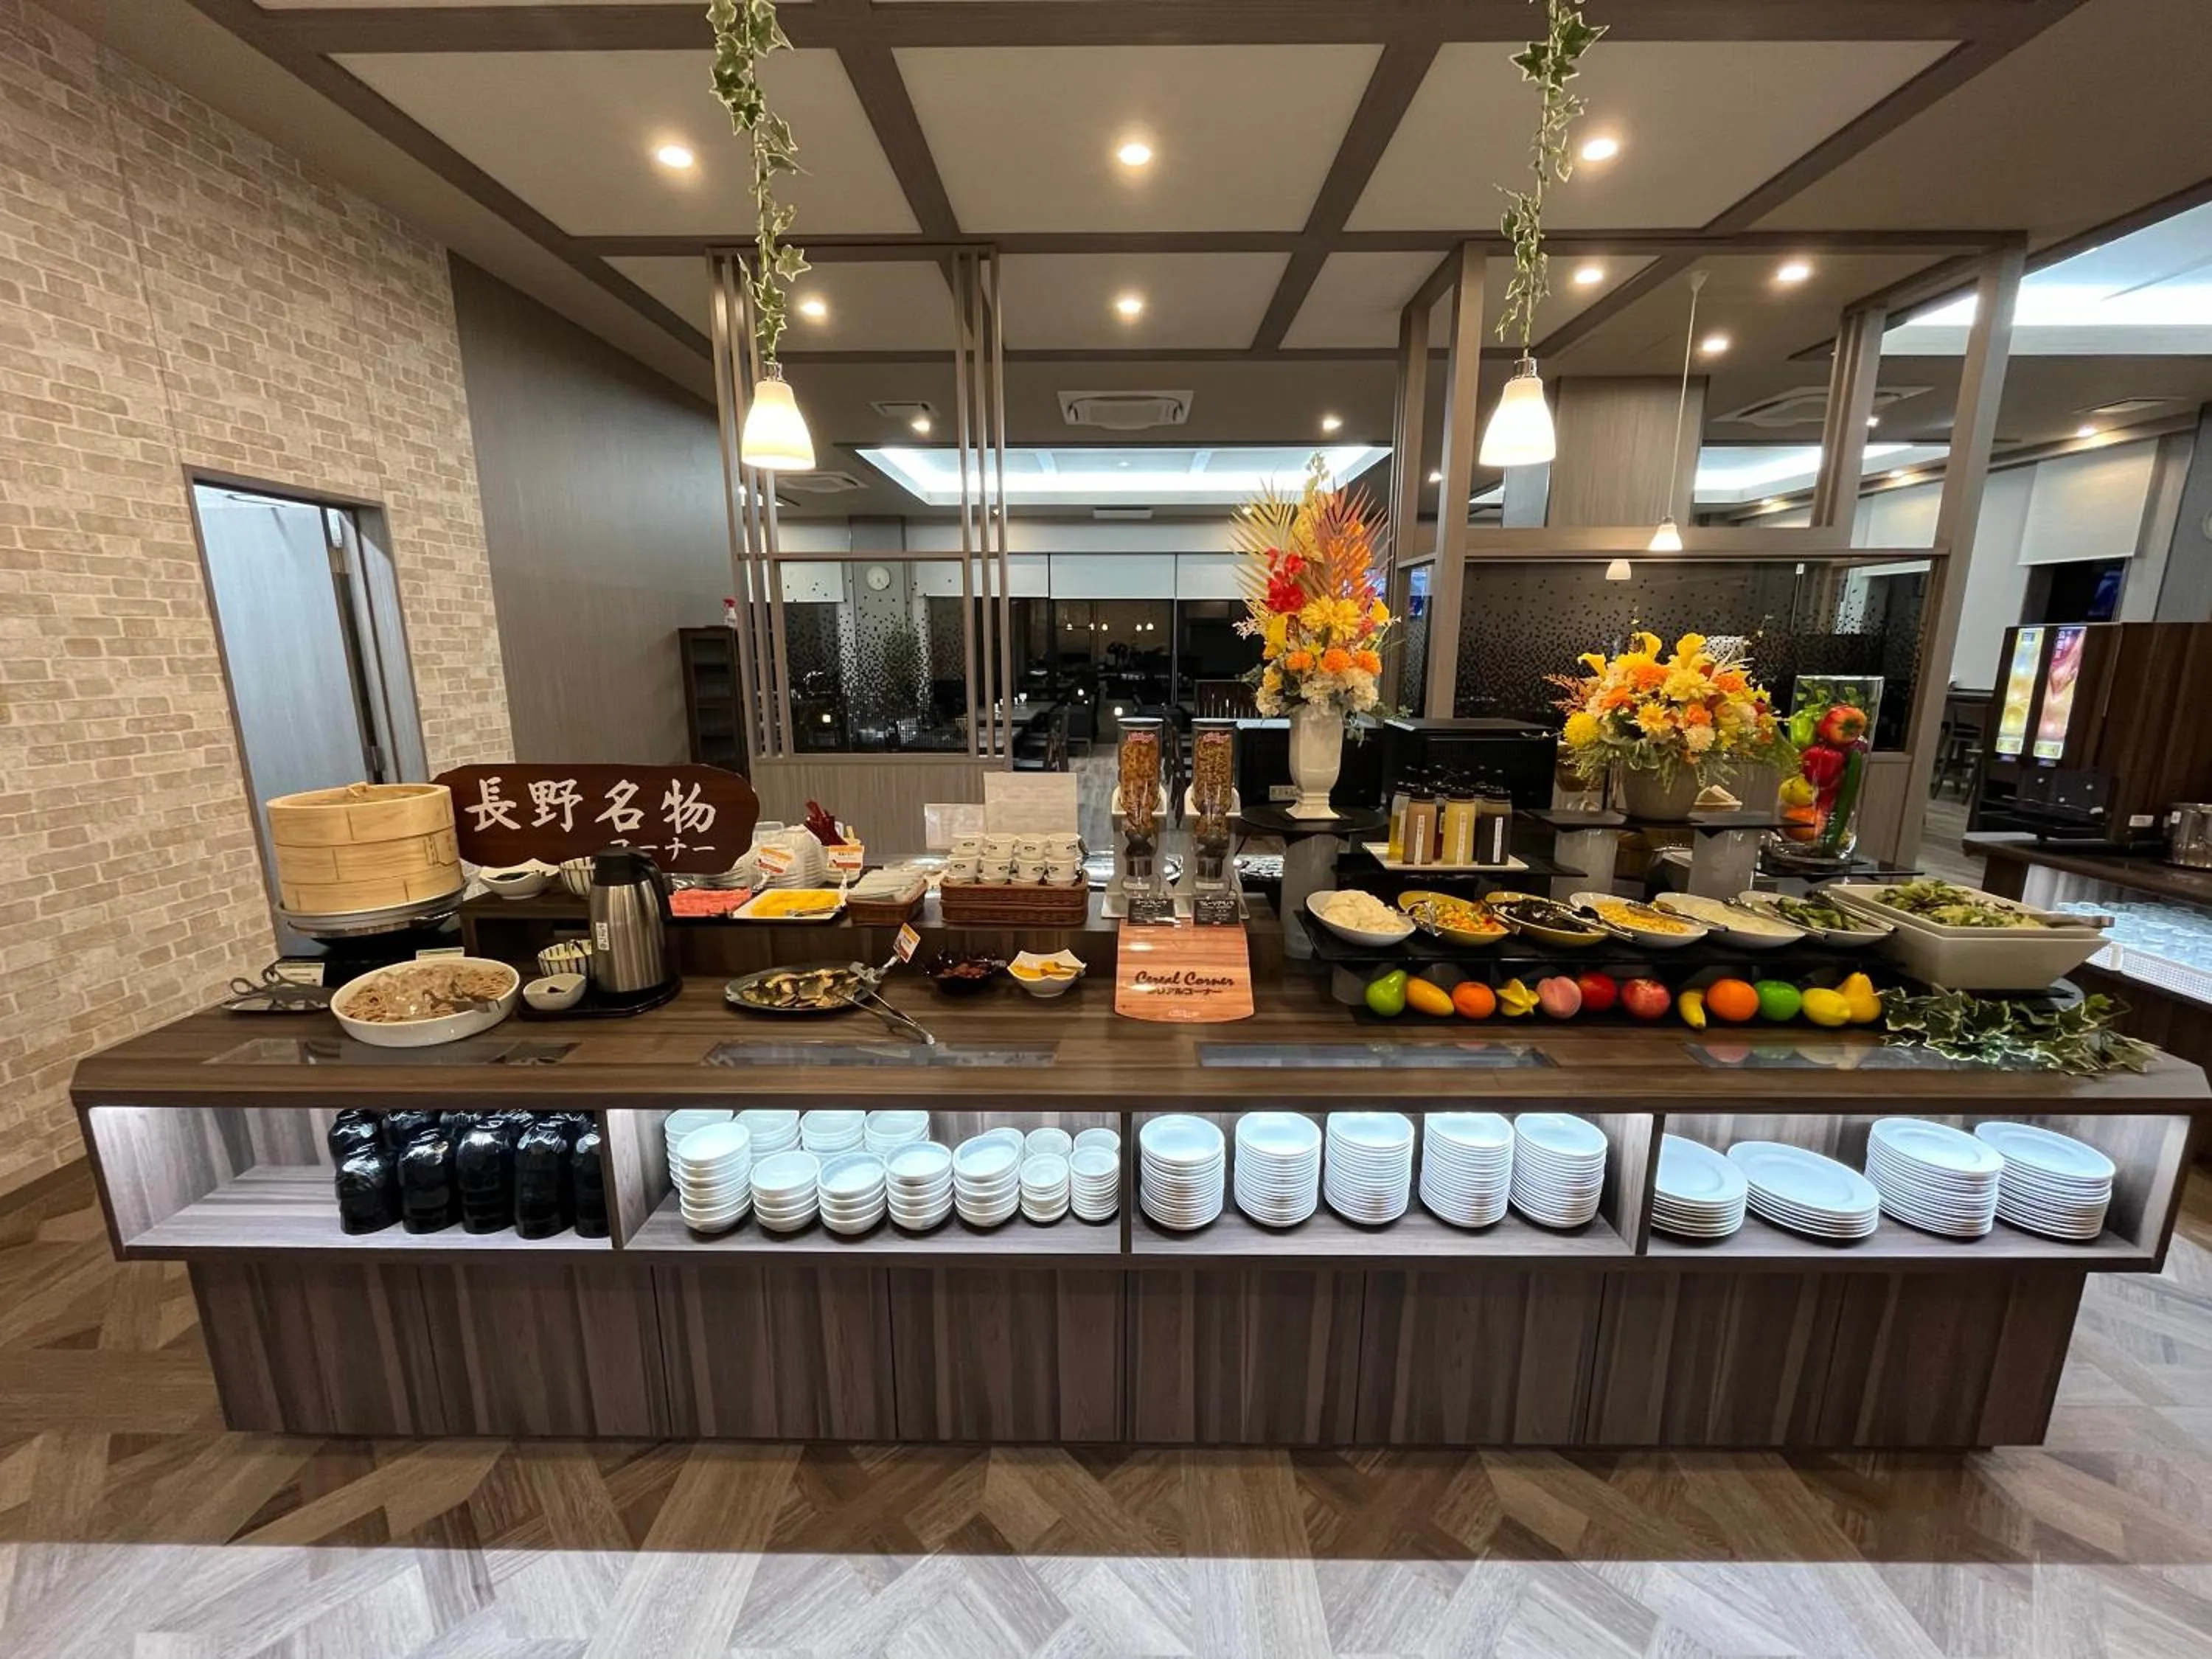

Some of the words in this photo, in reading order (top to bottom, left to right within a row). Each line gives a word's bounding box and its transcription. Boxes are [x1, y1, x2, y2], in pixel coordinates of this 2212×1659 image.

[465, 776, 716, 834] 長野名物
[1135, 971, 1180, 985] Cereal
[1183, 971, 1234, 987] Corner
